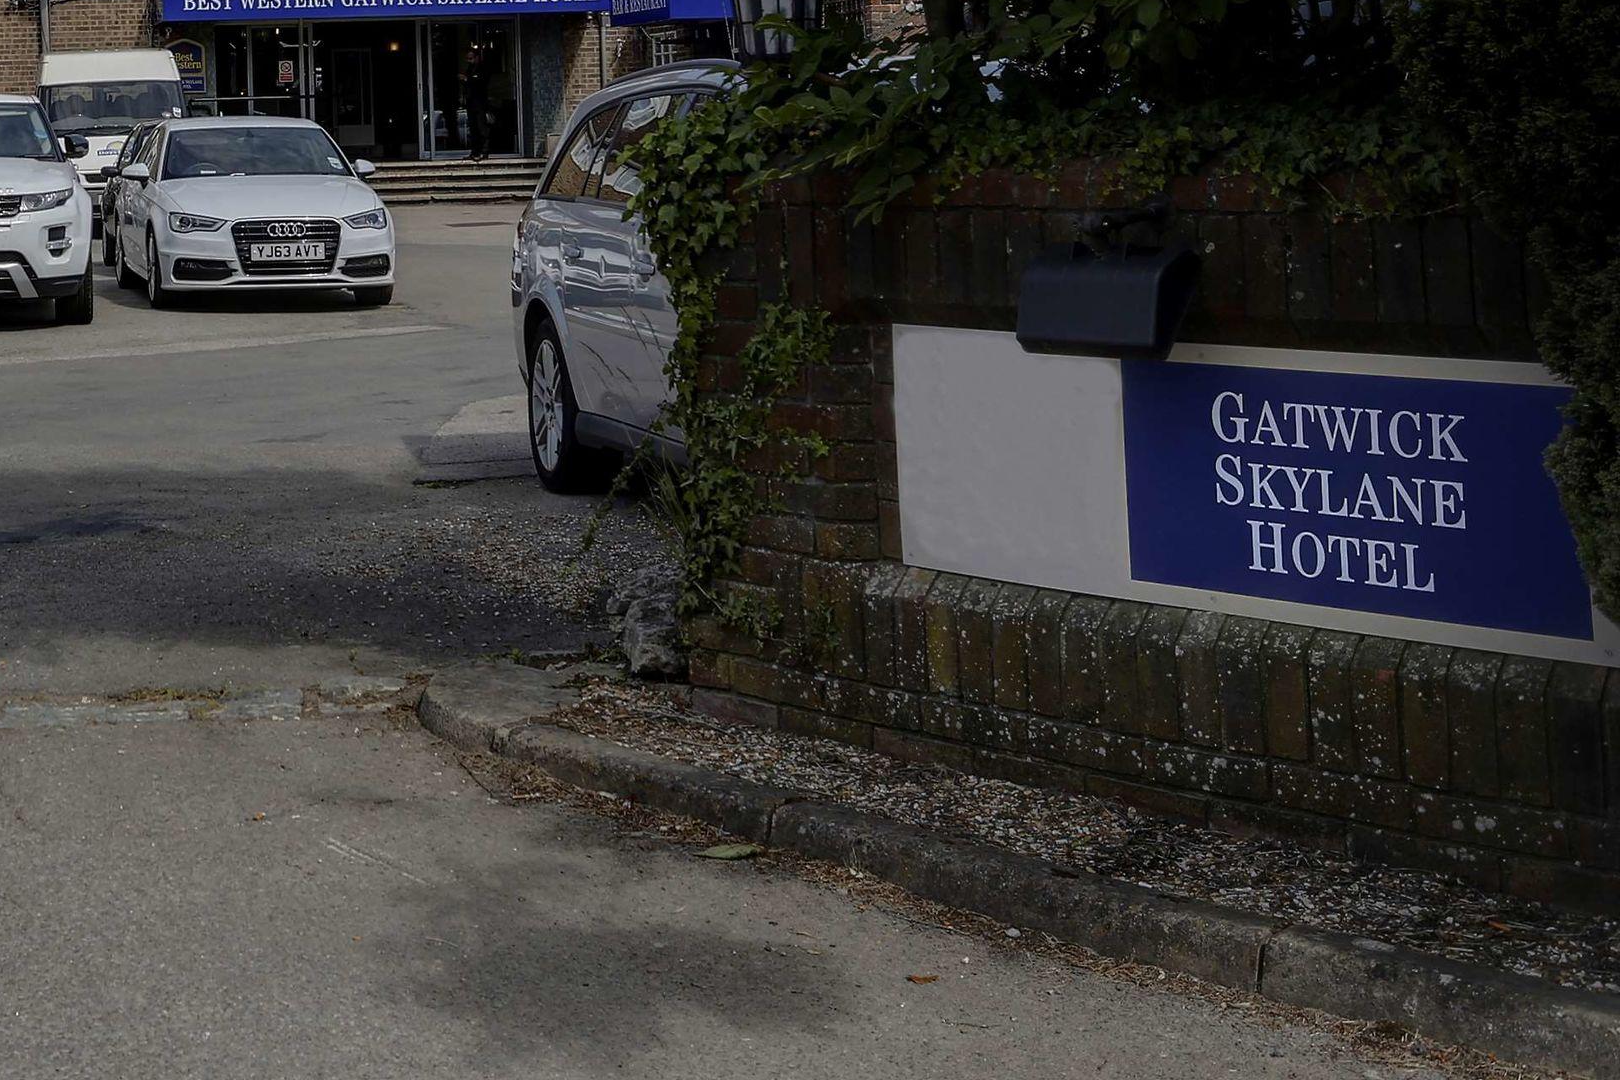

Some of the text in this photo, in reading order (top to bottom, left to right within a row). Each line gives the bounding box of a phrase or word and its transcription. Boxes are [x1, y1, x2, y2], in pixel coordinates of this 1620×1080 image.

[175, 52, 194, 61] Best
[176, 61, 202, 70] estern
[257, 244, 320, 258] YJ63 AVT
[1210, 391, 1469, 463] GATWICK
[1214, 453, 1467, 530] SKYLANE
[1246, 519, 1436, 593] HOTEL
